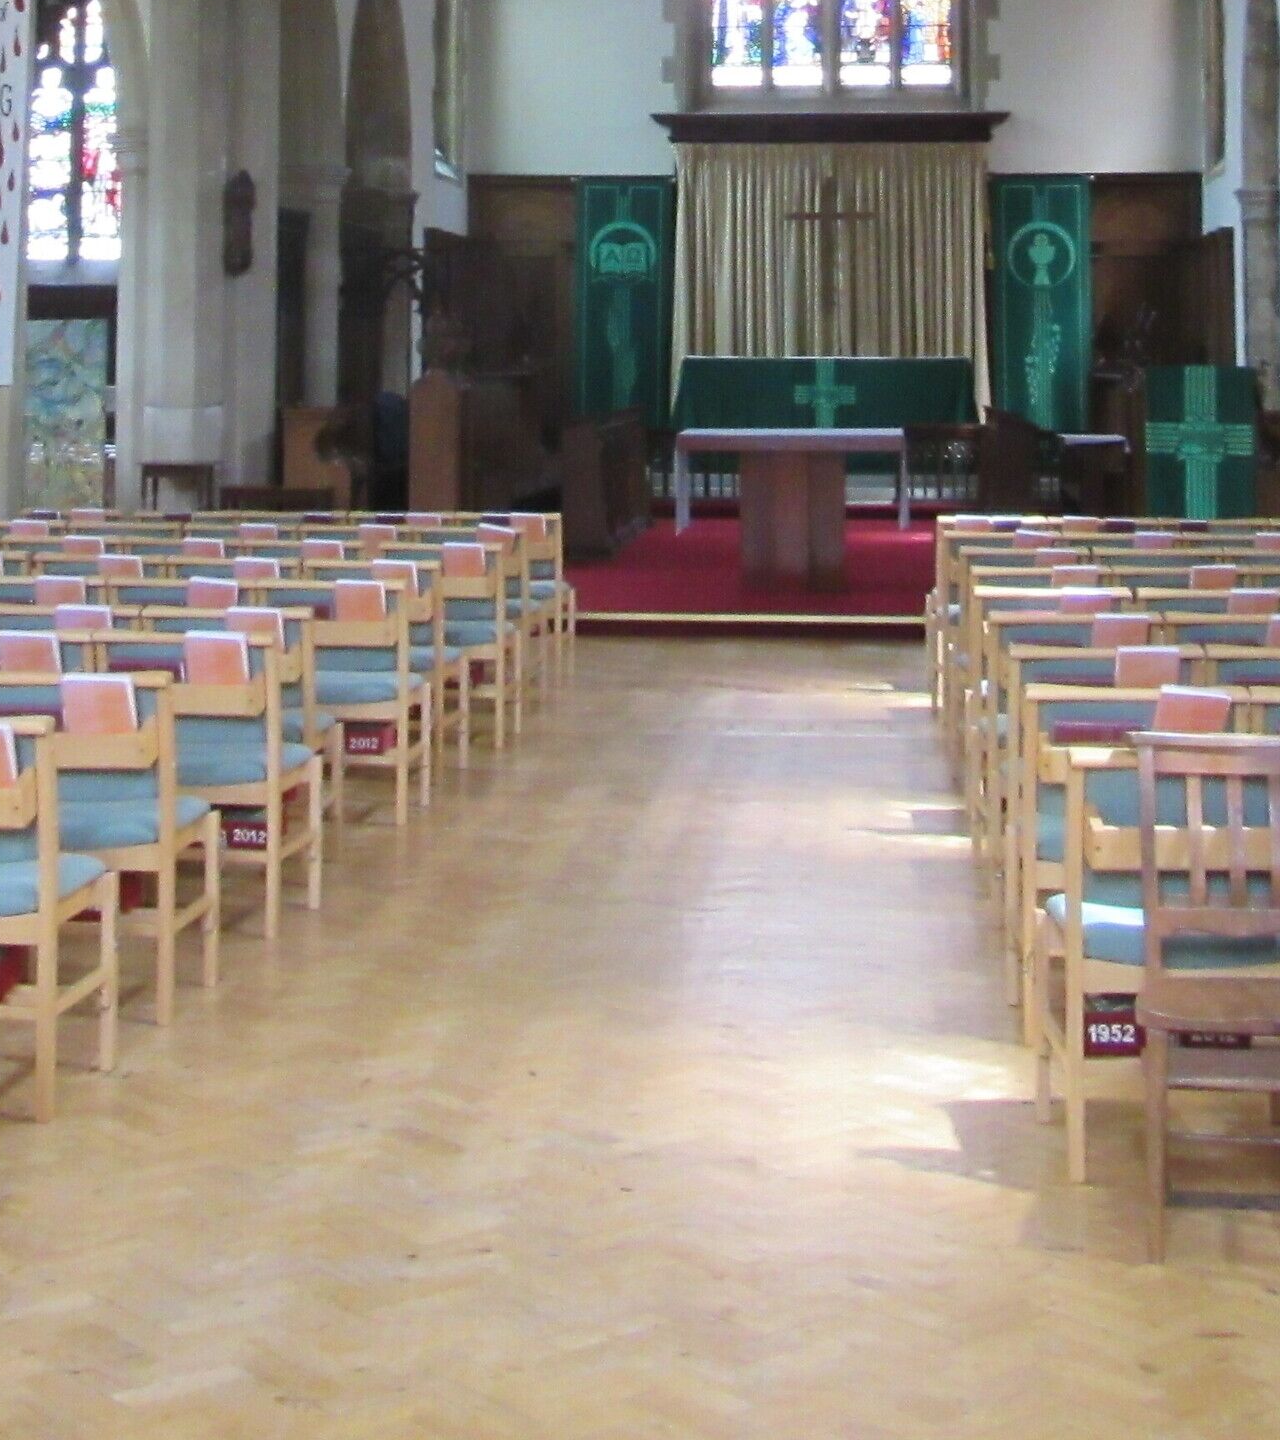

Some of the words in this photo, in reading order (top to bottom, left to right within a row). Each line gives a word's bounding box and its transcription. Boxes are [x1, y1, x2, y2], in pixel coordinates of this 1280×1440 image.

[349, 736, 380, 750] 2012
[232, 828, 267, 844] 2012
[1087, 1023, 1135, 1043] 1952
